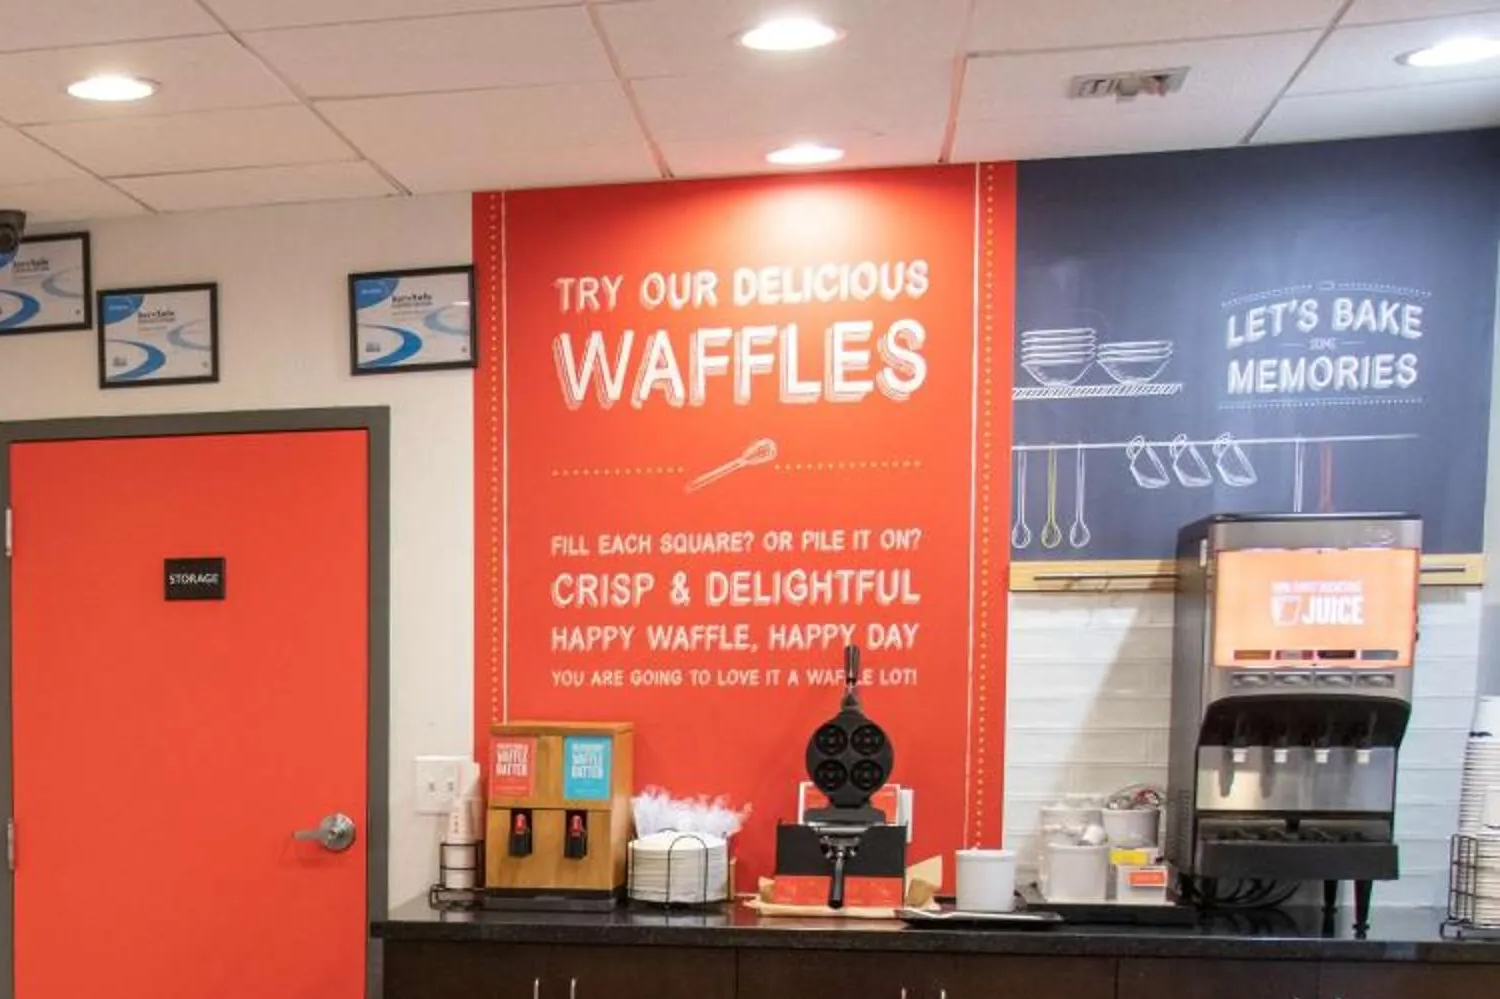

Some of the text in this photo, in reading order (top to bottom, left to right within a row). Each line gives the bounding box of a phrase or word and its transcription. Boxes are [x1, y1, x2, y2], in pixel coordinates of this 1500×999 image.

[553, 259, 929, 313] TRY OUR DELICIOUS
[1227, 297, 1424, 349] LET'S BAKE
[552, 318, 927, 411] WAFFLES
[1227, 352, 1419, 395] MEMORIES
[551, 527, 922, 558] FILL EACH SQUARE? OR PILE IT ON?
[169, 573, 219, 585] STORAGE
[551, 567, 921, 609] CRISP & DELIGHTFUL
[1301, 597, 1365, 625] JUICE
[551, 622, 919, 653] HAPPY WAFFLE, HAPPY DAY
[552, 667, 918, 689] YOU ARE GOING TO LOVE IT A WAFE LOT!
